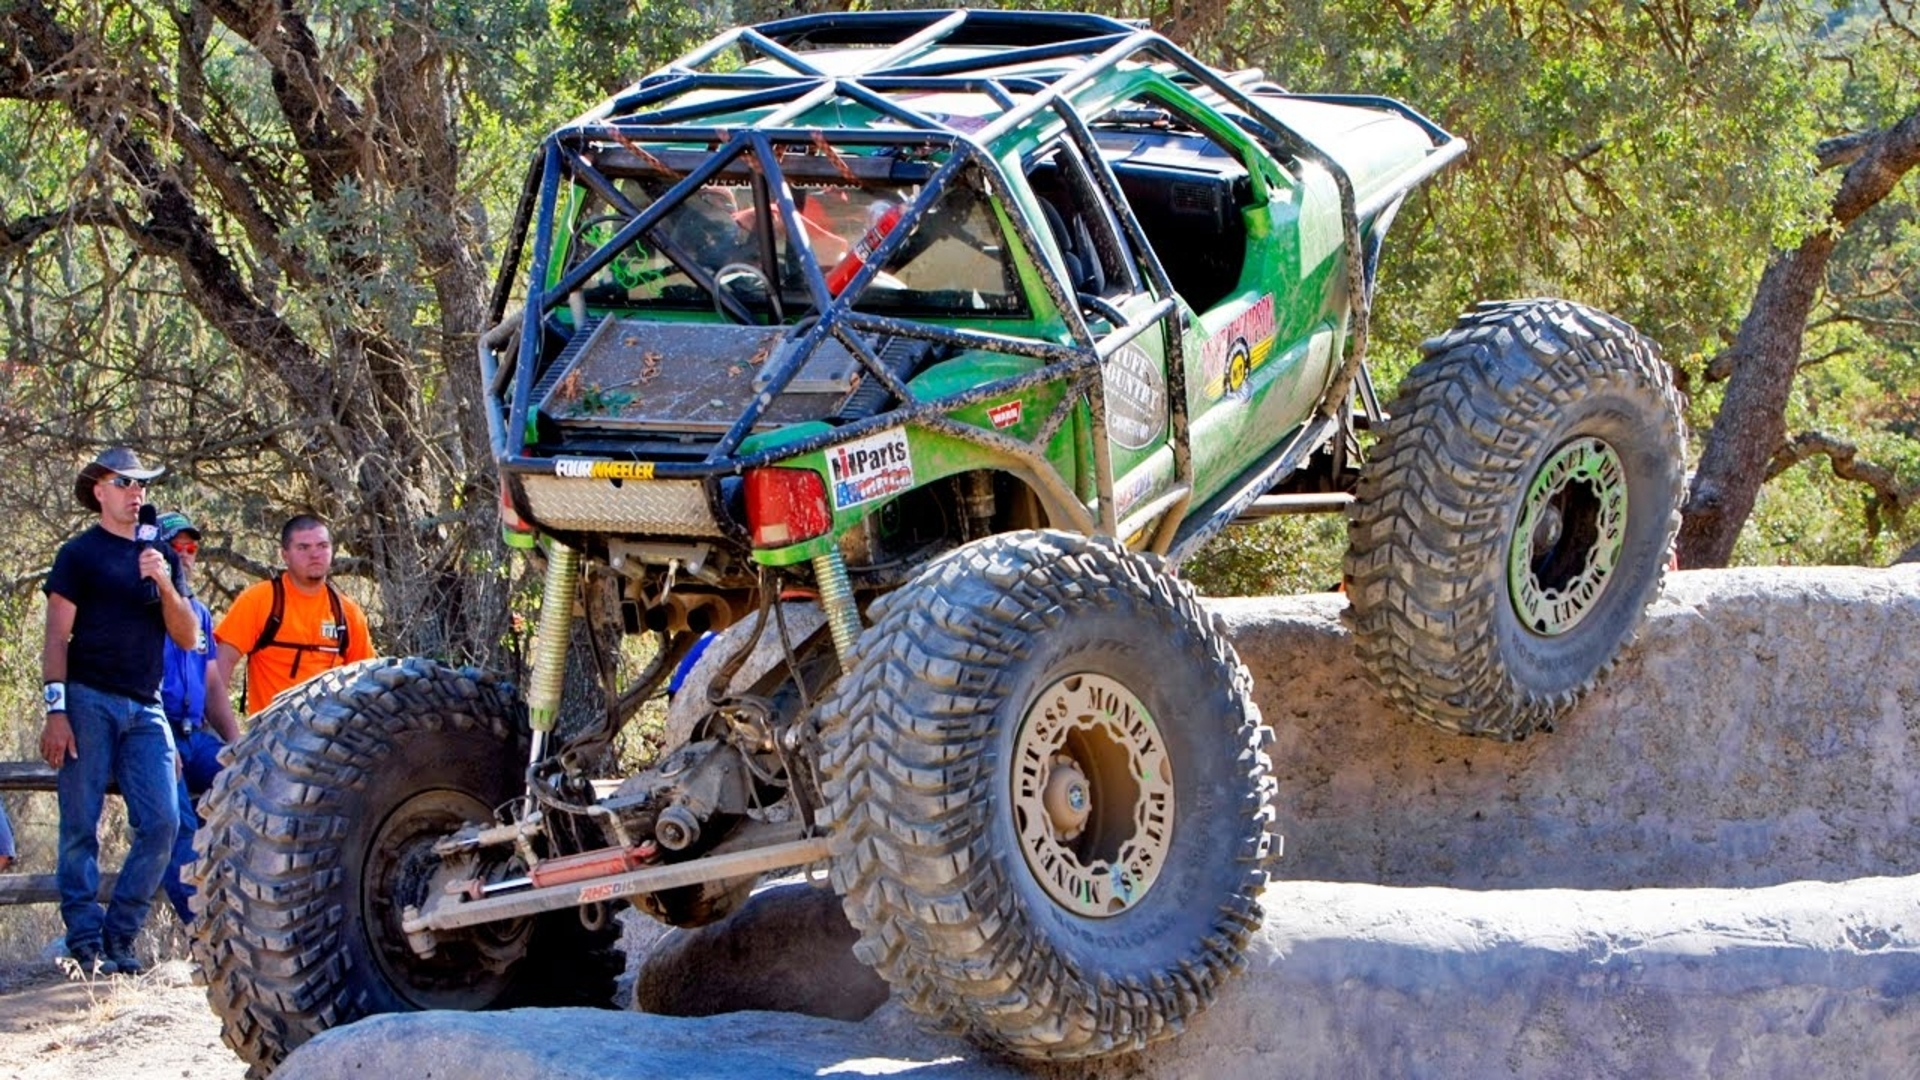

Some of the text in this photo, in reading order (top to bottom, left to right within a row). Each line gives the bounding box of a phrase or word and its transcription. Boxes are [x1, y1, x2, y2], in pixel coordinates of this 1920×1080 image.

[1106, 362, 1160, 412] OUNTRY
[1087, 685, 1158, 757] MONEY
[1030, 835, 1101, 904] MONEY
